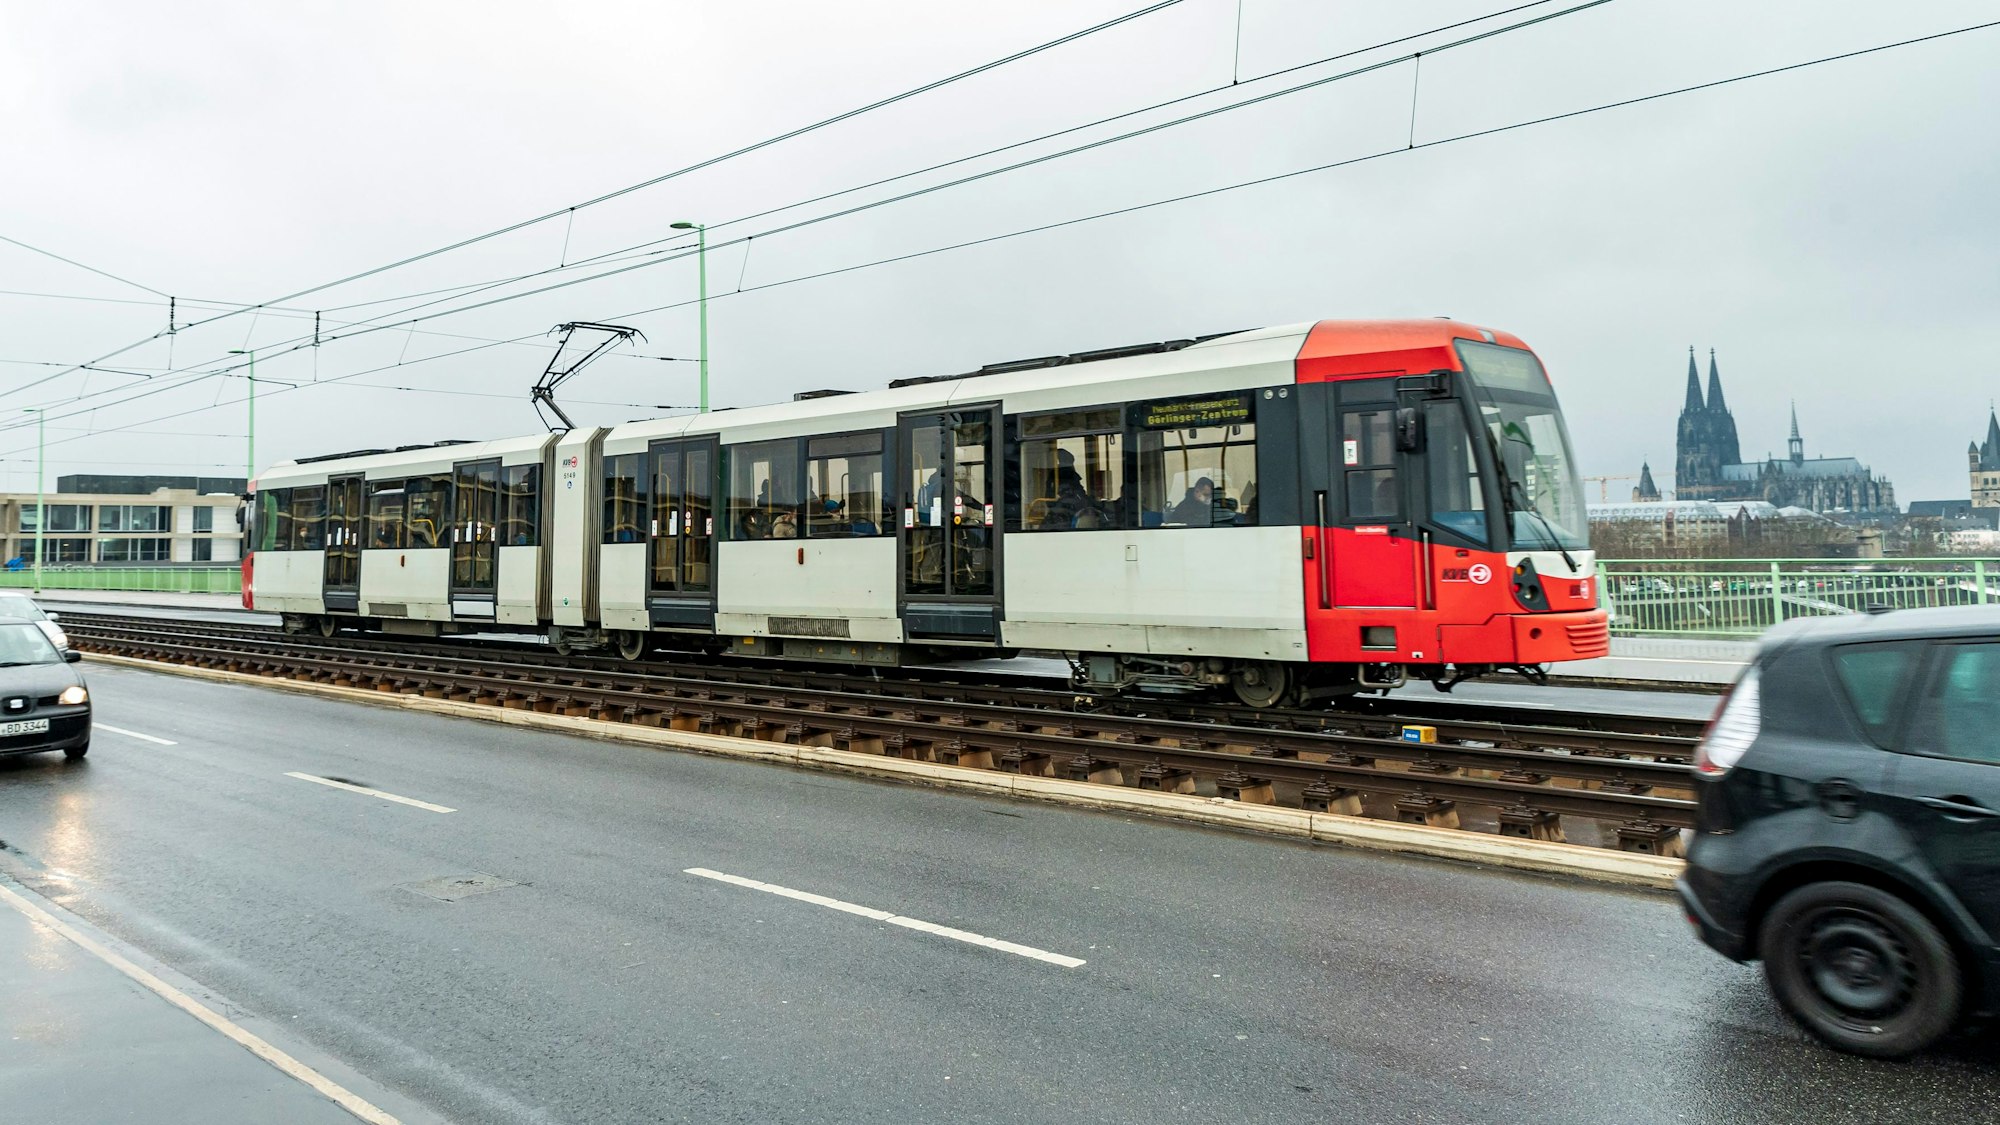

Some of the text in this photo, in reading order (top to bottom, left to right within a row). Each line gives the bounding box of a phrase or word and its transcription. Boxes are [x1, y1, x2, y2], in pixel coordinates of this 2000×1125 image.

[1442, 568, 1468, 580] KVB
[7, 720, 47, 734] BD 3344
